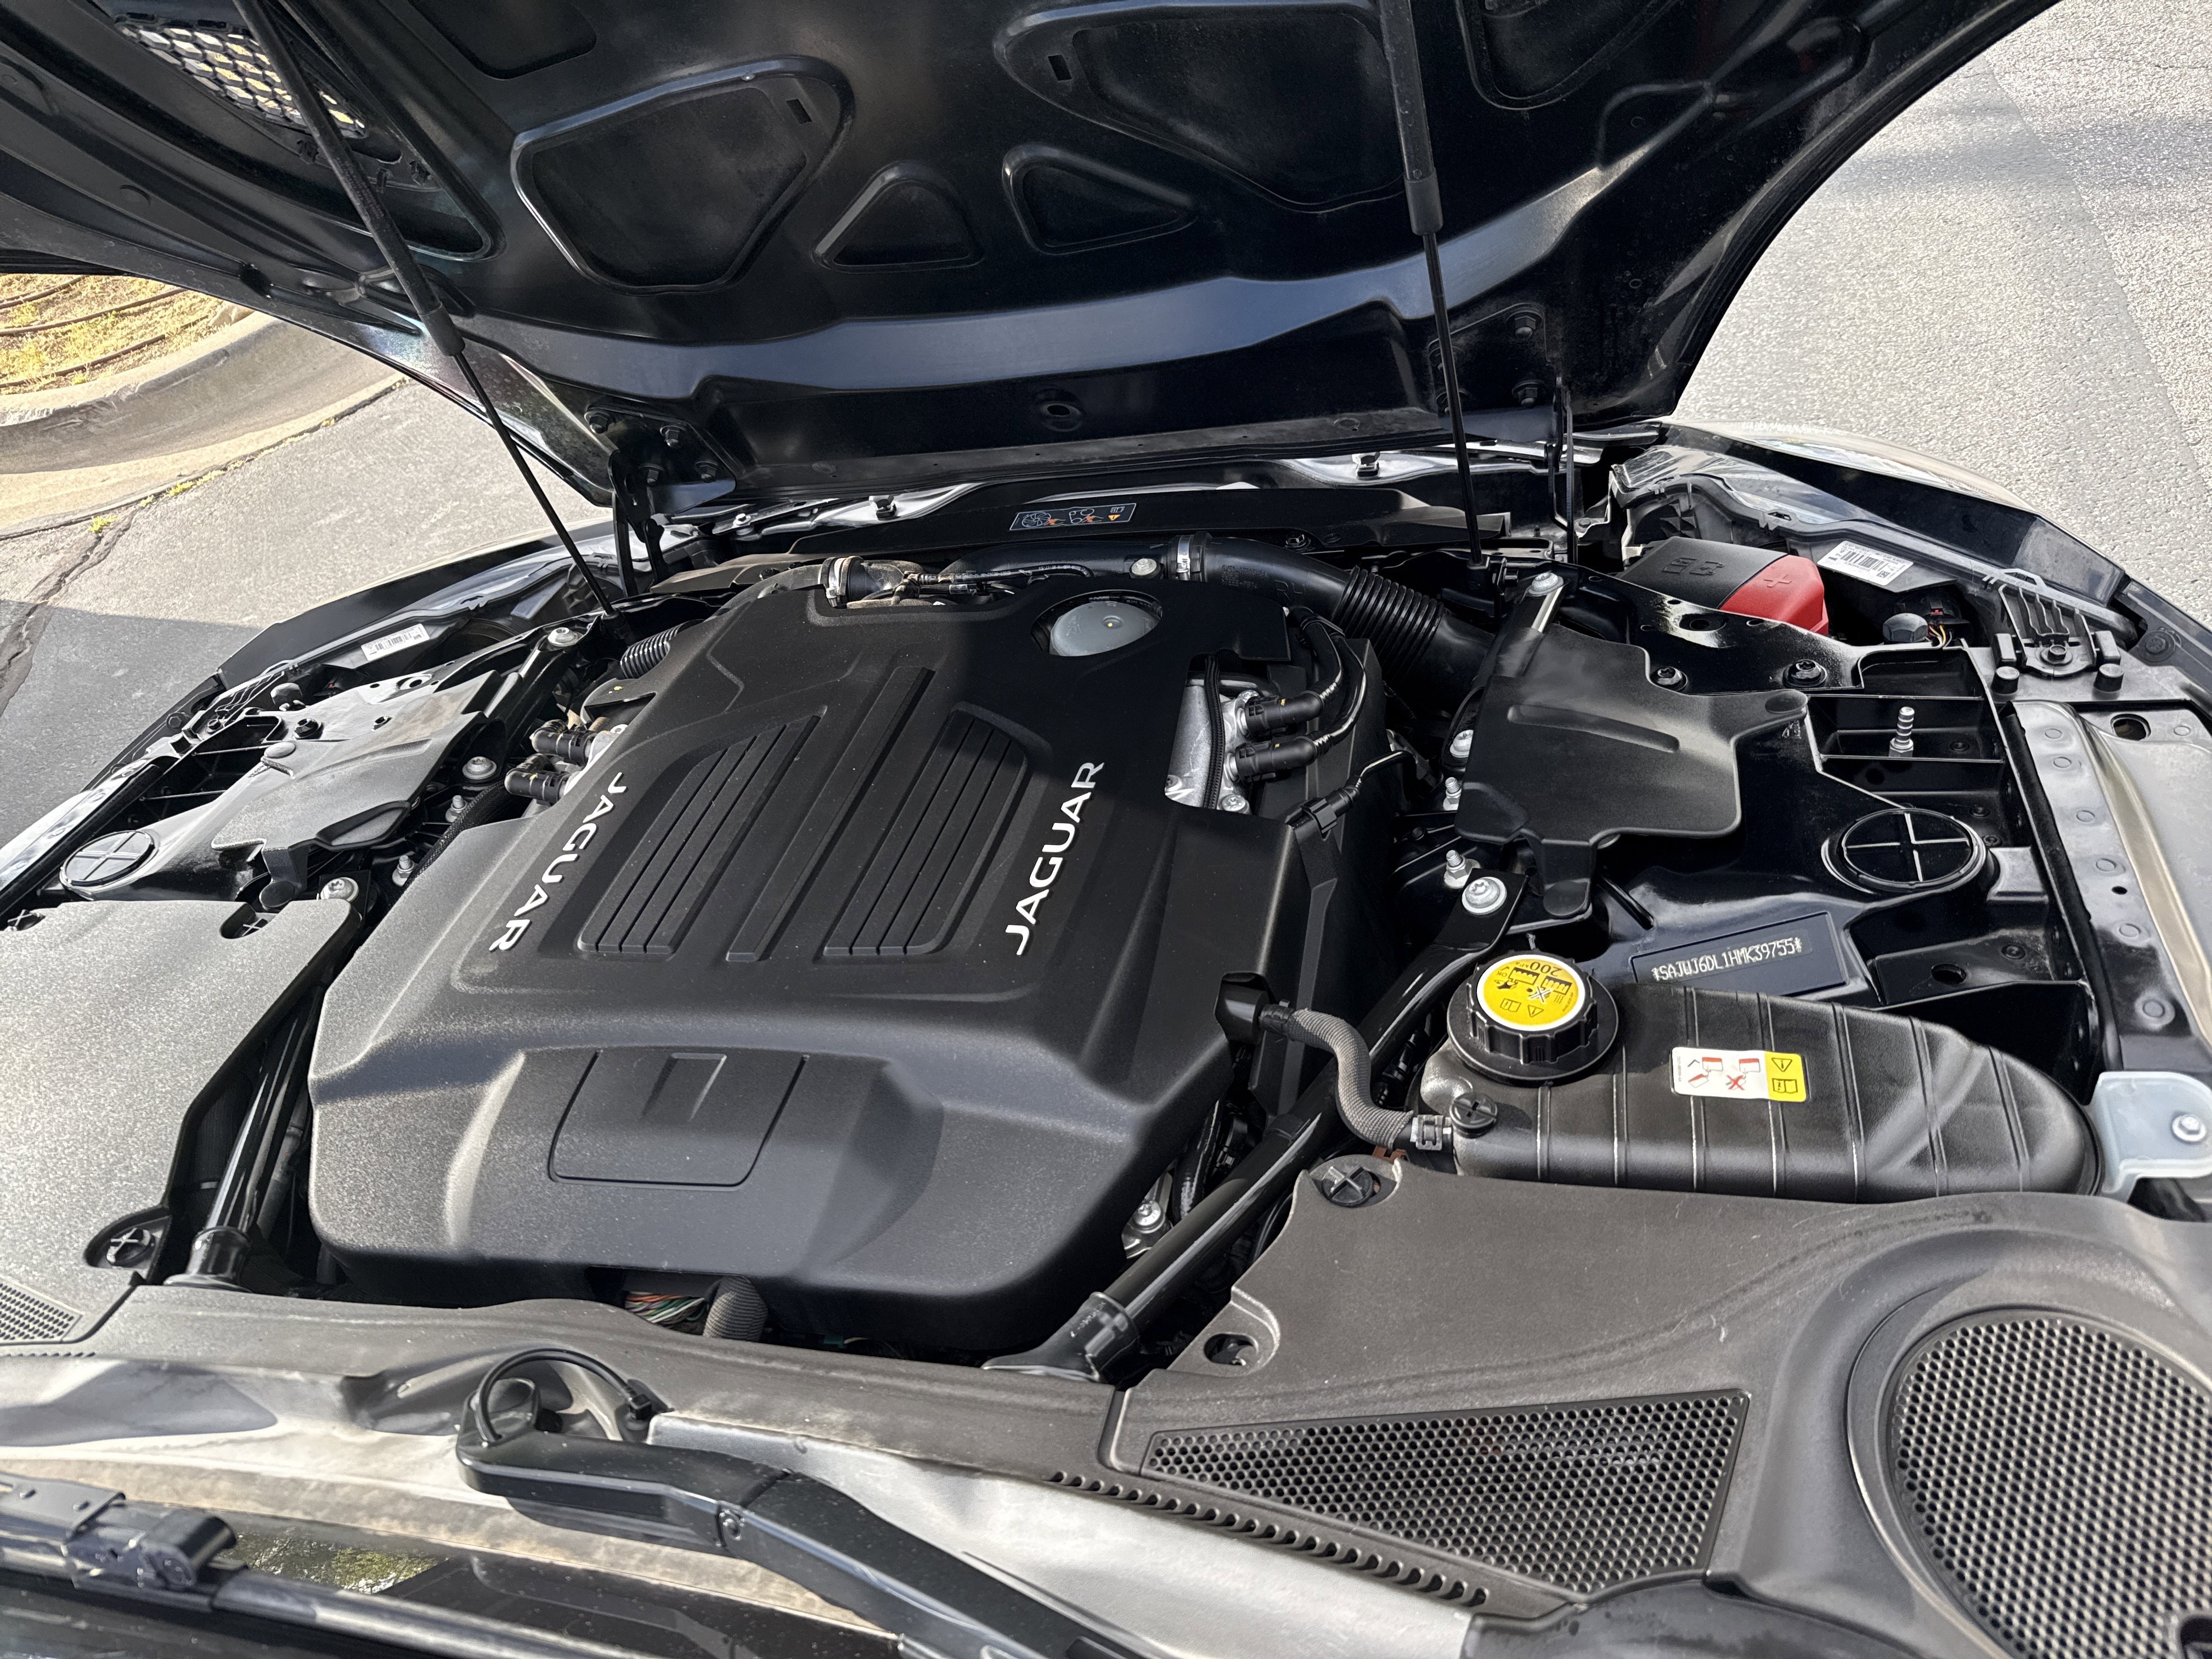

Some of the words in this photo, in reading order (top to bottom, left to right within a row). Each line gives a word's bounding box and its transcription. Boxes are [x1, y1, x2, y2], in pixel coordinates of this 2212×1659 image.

[489, 772, 627, 951] JAGUAR
[1005, 762, 1105, 956] JAGUAR
[1530, 961, 1562, 977] 200
